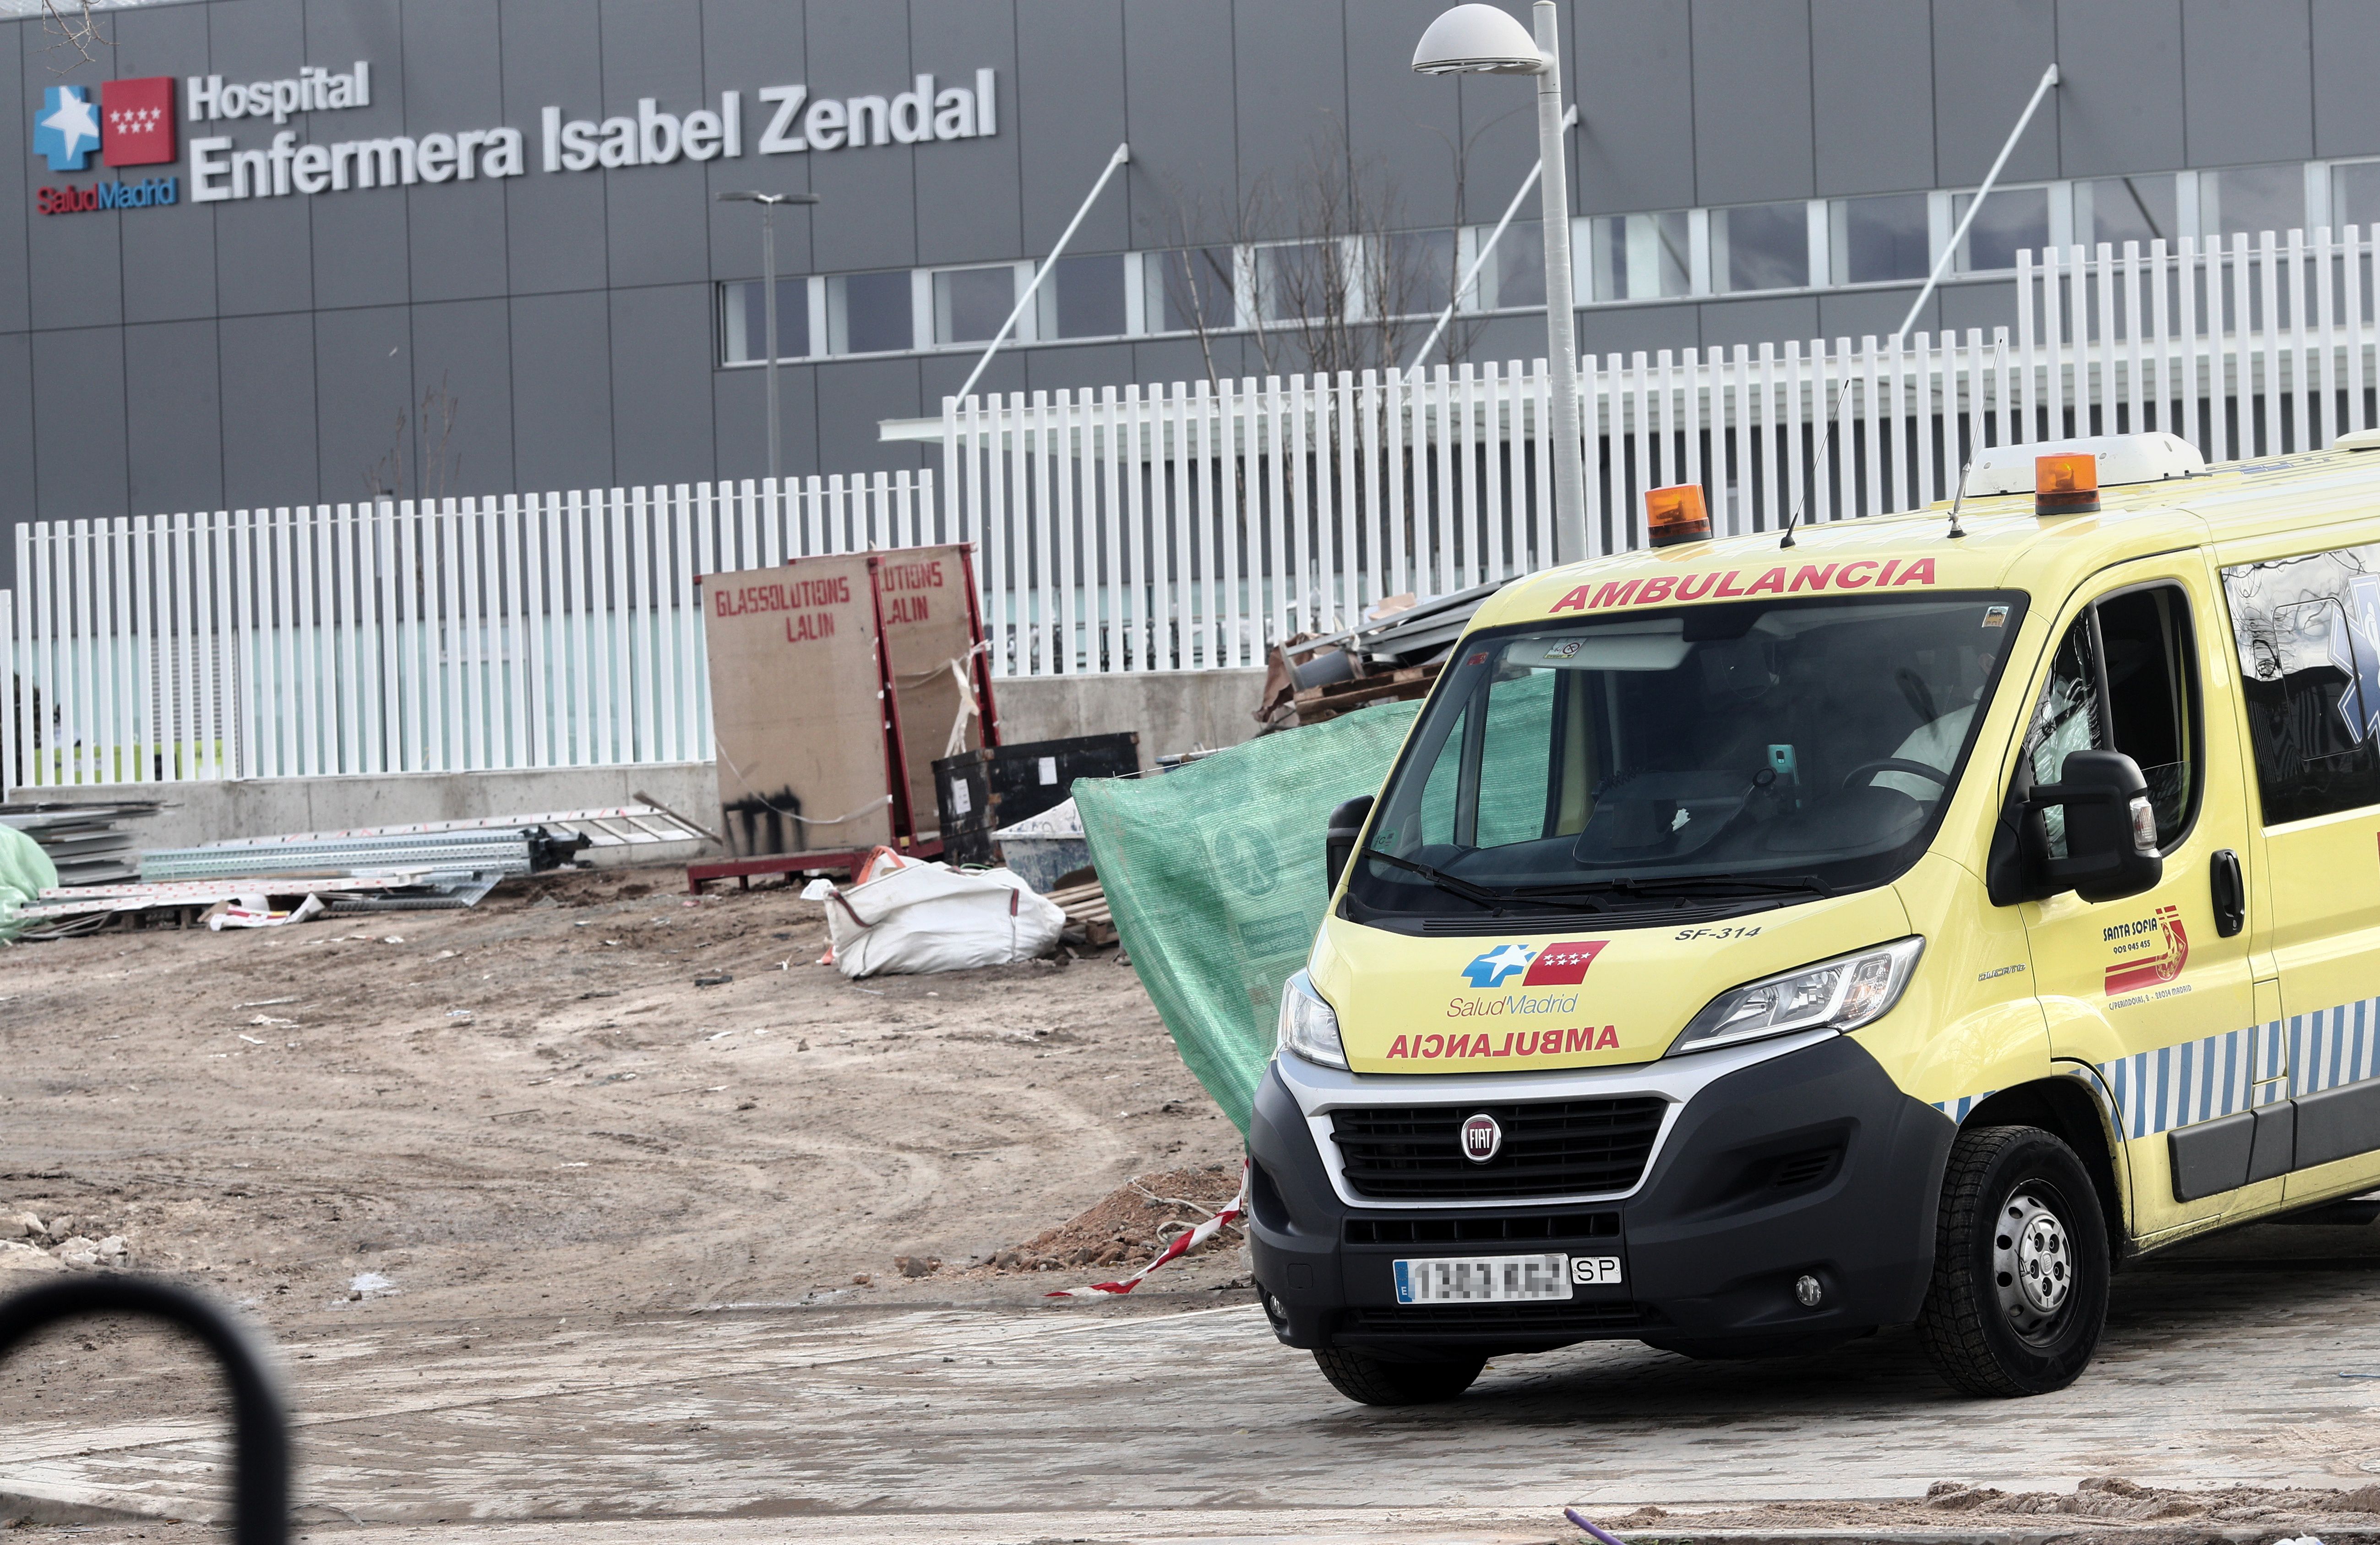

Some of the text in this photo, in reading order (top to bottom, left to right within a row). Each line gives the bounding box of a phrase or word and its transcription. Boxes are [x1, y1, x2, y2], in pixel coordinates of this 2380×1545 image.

[188, 61, 369, 123] Hospital
[190, 68, 995, 202] Enfermera Isabel Zendal
[37, 176, 178, 215] SaludMadrid
[882, 561, 942, 592] UTIONS
[1549, 558, 1936, 614] AMBULANCIA
[715, 577, 850, 617] GLASSOLUTIONS
[786, 613, 835, 642] LALIN
[1674, 926, 1762, 941] SF-314
[2103, 918, 2157, 941] SANTA SOFIA
[2113, 940, 2150, 954] 902 945 455
[2171, 985, 2192, 996] MADRID
[1447, 993, 1579, 1017] SaludMadrid
[1469, 1128, 1492, 1149] FIAT
[1576, 1260, 1615, 1281] SP
[1401, 1286, 1408, 1295] E
